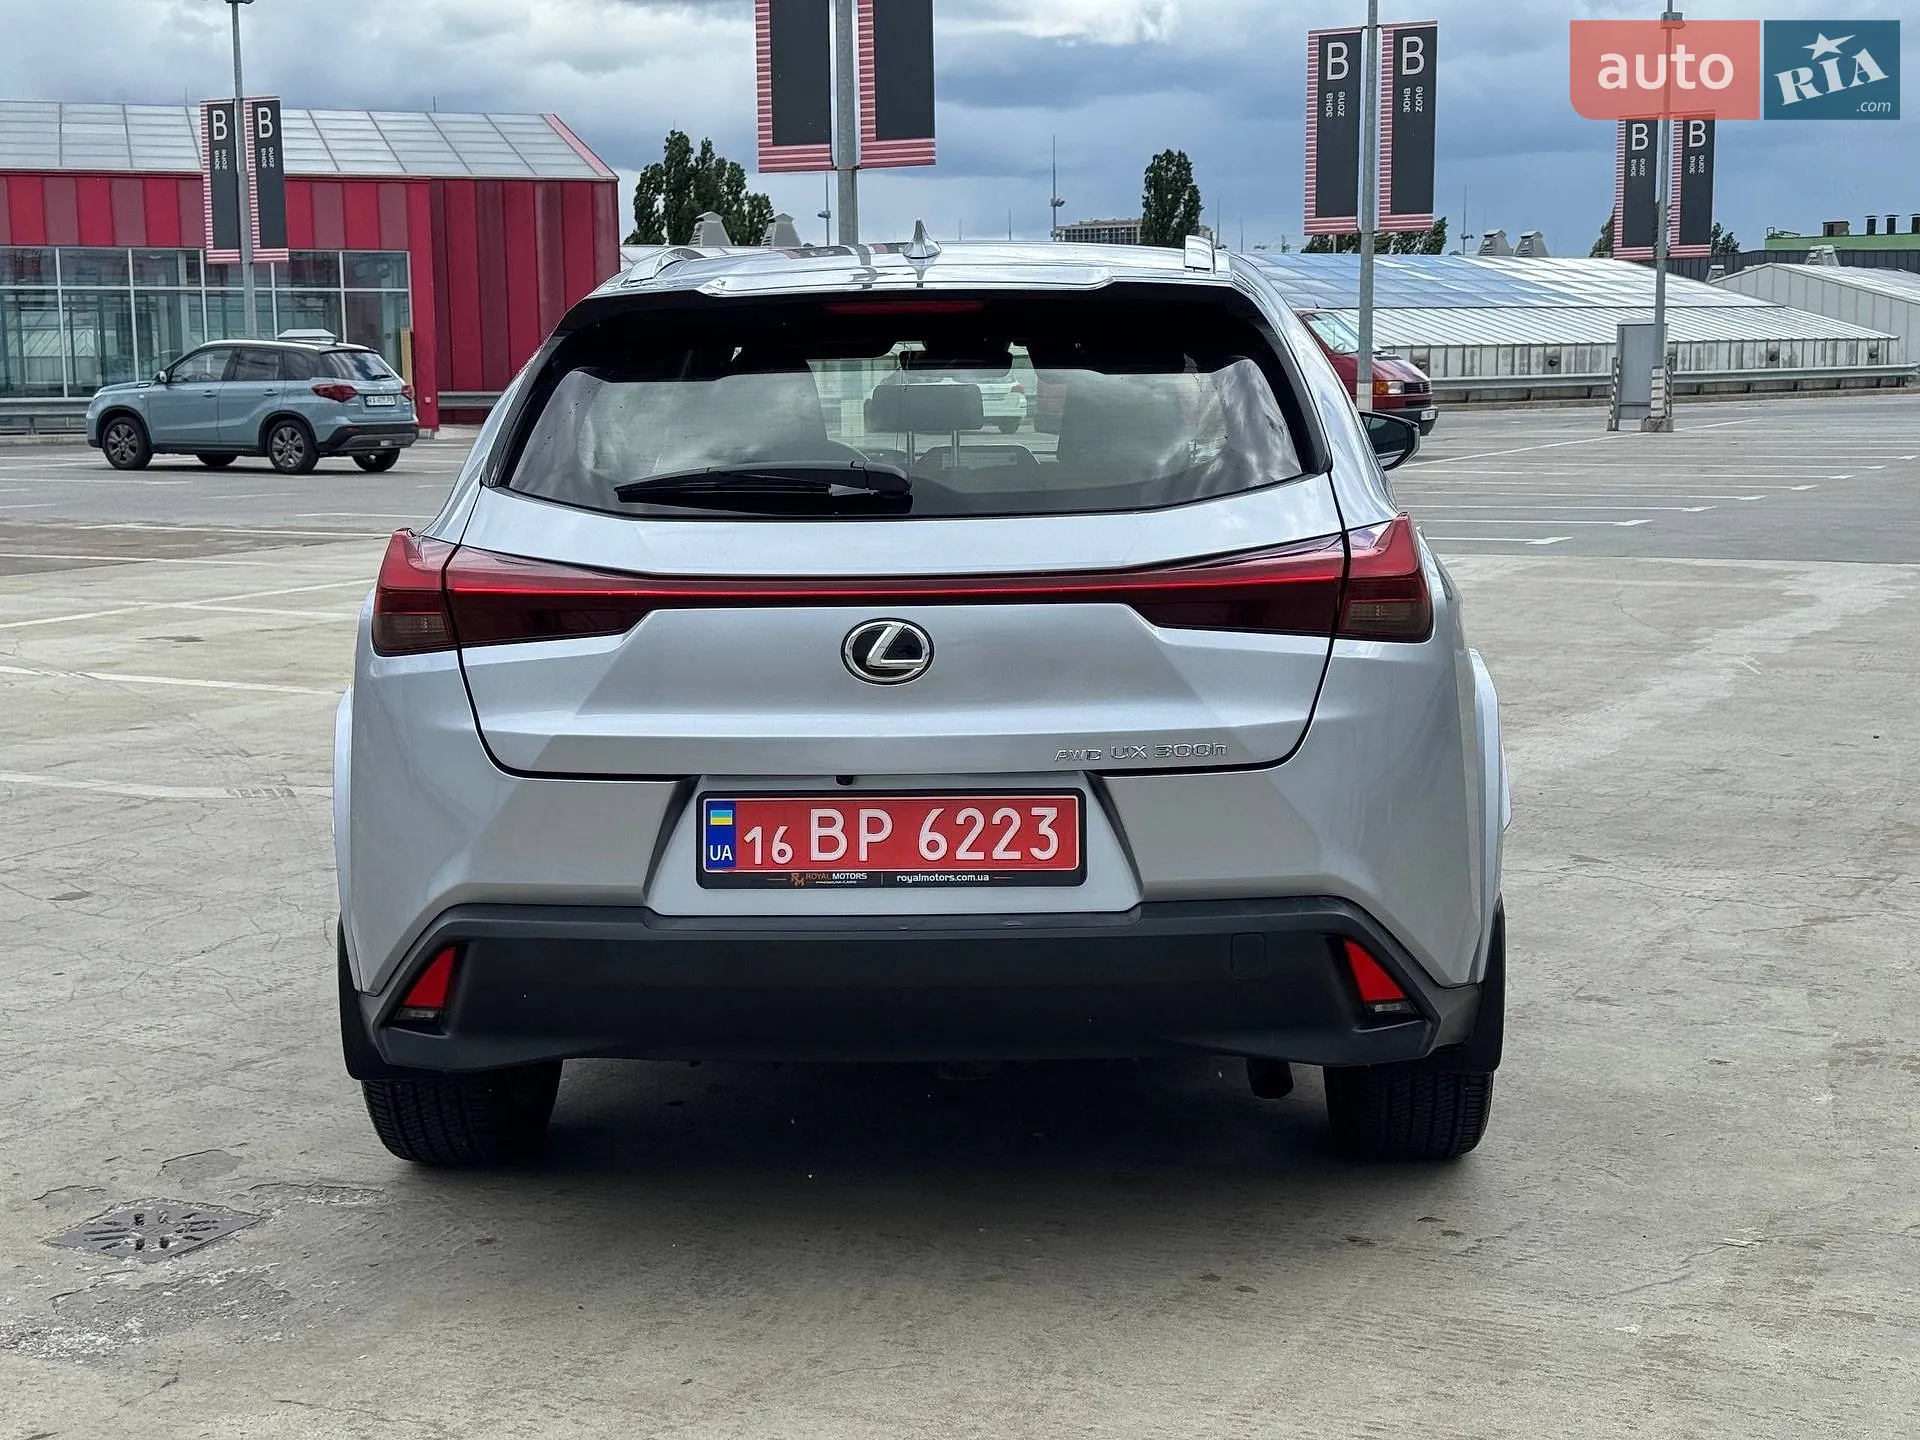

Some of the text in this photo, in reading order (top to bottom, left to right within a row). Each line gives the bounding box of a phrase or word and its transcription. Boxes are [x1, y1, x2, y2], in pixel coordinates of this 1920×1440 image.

[1326, 41, 1349, 81] B
[1401, 36, 1425, 75] B
[1337, 91, 1345, 117] zone
[1415, 86, 1424, 112] zone
[212, 110, 227, 140] B
[257, 107, 273, 138] B
[1688, 120, 1706, 148] B
[1631, 123, 1649, 151] B
[1054, 742, 1228, 761] AWD UX 300h
[743, 806, 1060, 866] 16 BP 6223
[709, 845, 733, 861] UA
[832, 872, 868, 880] MOTORS
[896, 873, 990, 883] royalmotors.com.ua
